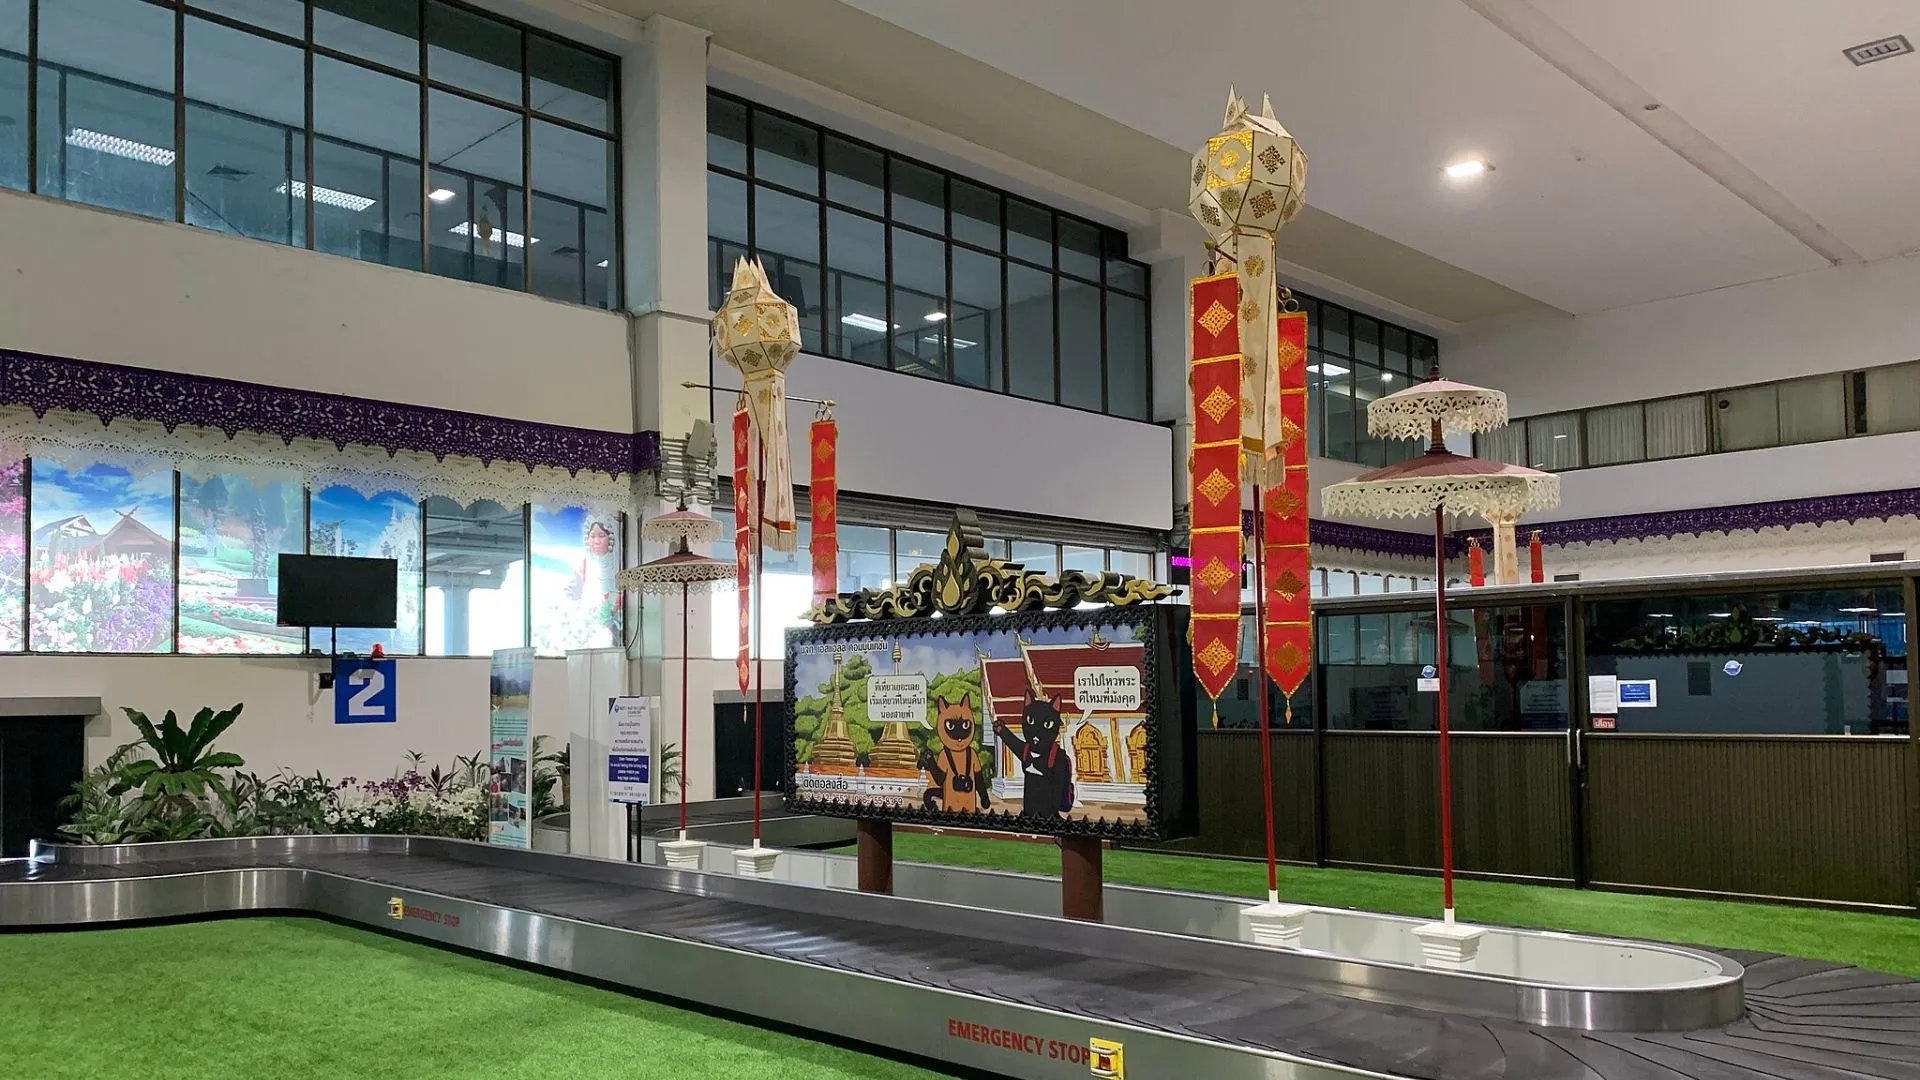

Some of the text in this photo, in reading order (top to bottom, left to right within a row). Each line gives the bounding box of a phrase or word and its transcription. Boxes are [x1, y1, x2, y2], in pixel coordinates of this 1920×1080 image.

[348, 669, 385, 716] 2
[1077, 669, 1136, 686] เราไปไหว้พระ
[947, 1019, 1091, 1066] EMERGENCY STOP
